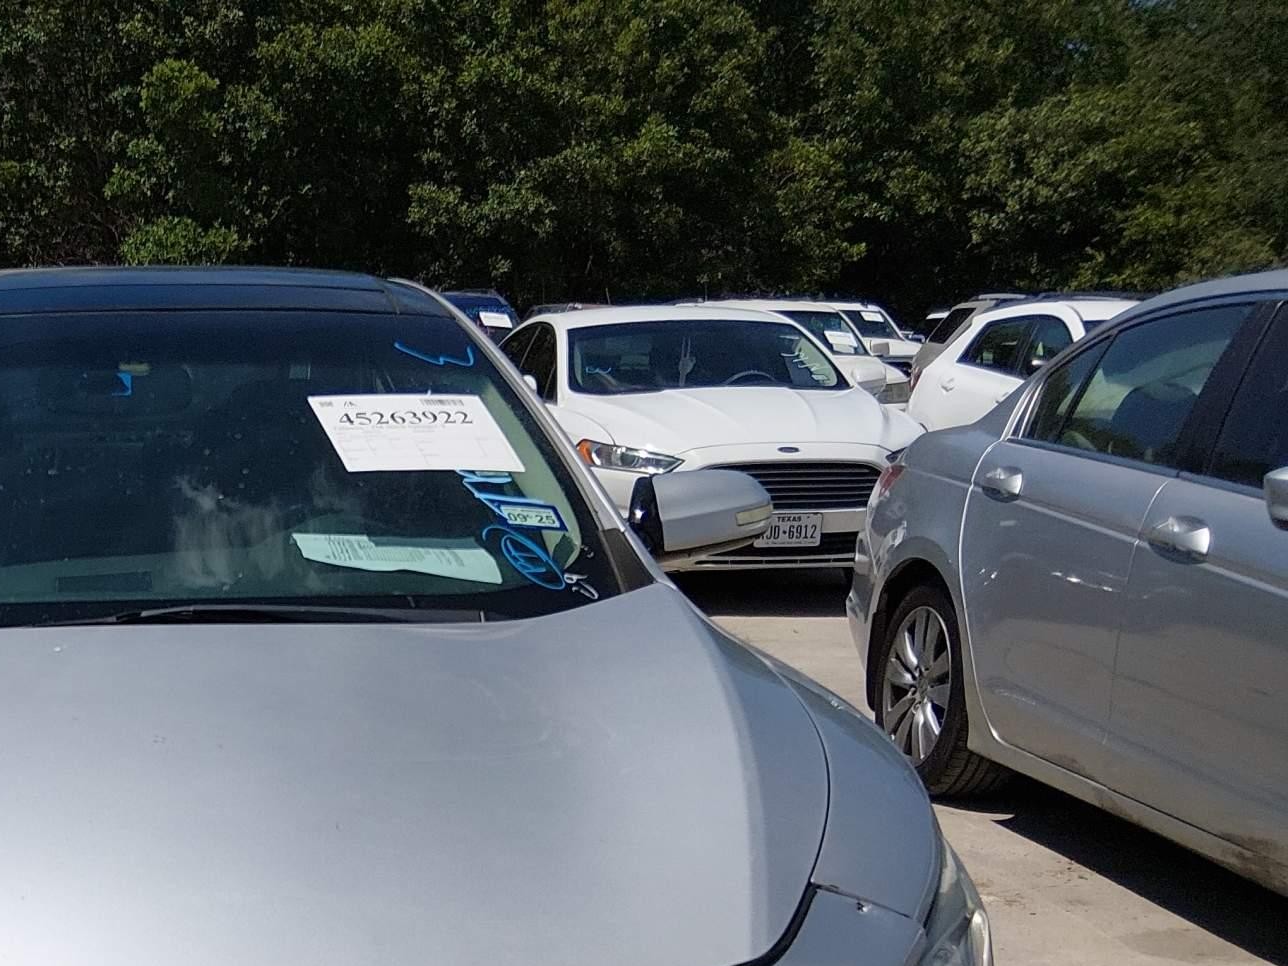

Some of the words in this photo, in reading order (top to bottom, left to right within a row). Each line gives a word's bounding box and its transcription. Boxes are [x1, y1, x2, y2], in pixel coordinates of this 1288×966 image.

[339, 410, 474, 426] 45263922
[507, 512, 527, 523] 09
[535, 514, 556, 525] 25
[777, 515, 802, 523] TEXAS
